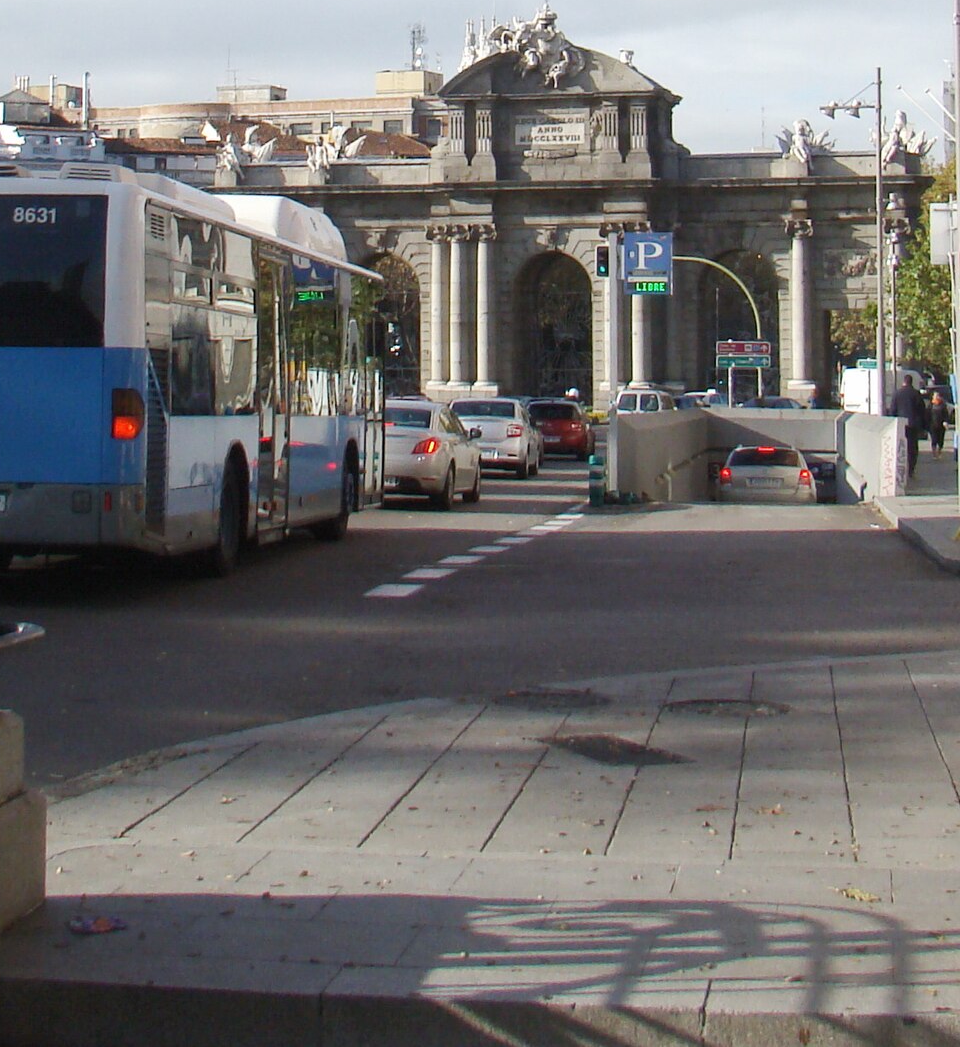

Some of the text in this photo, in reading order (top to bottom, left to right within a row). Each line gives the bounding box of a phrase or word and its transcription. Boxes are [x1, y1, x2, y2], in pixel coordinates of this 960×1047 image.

[537, 126, 563, 134] ANNO
[13, 206, 57, 224] 8631
[635, 241, 663, 270] P
[636, 282, 665, 292] LIBRE
